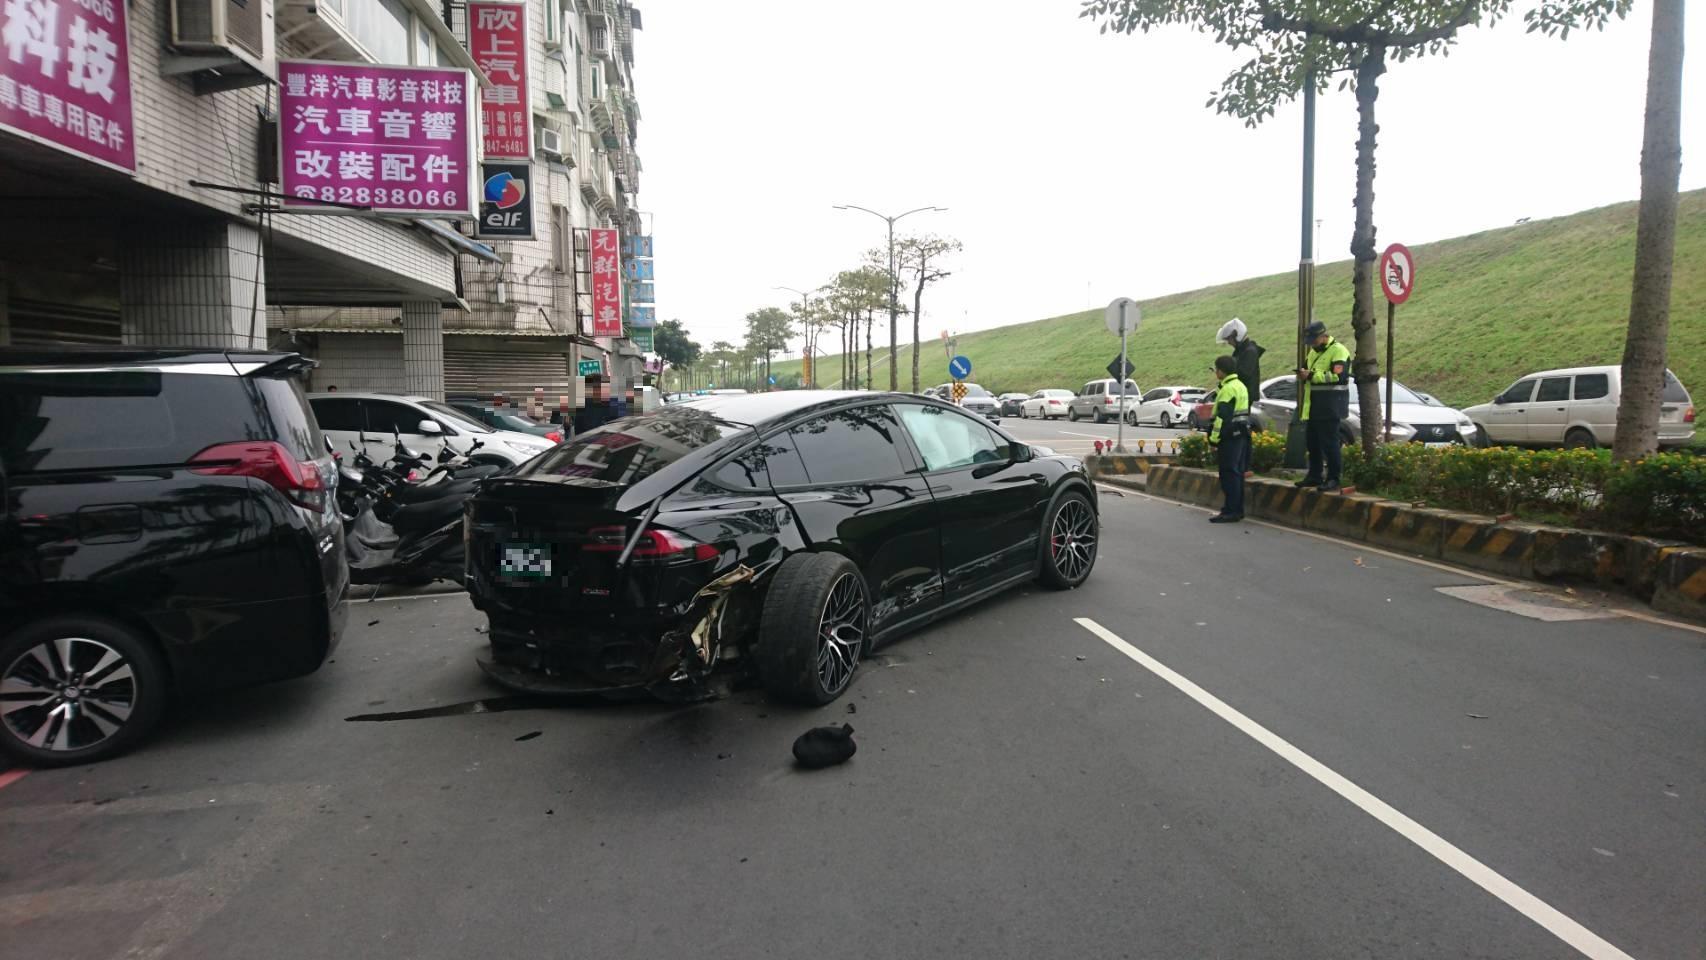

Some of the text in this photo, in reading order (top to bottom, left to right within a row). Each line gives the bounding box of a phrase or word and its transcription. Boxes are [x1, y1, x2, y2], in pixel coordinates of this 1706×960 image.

[0, 0, 118, 104] 科技
[477, 8, 520, 106] 欣上汽車
[286, 73, 463, 104] 豐洋汽車影音科技
[293, 105, 457, 141] 汽車音響
[294, 150, 458, 184] 改裝配件
[320, 186, 458, 207] 82838066
[486, 212, 523, 227] elf
[594, 231, 619, 328] 元群汽車
